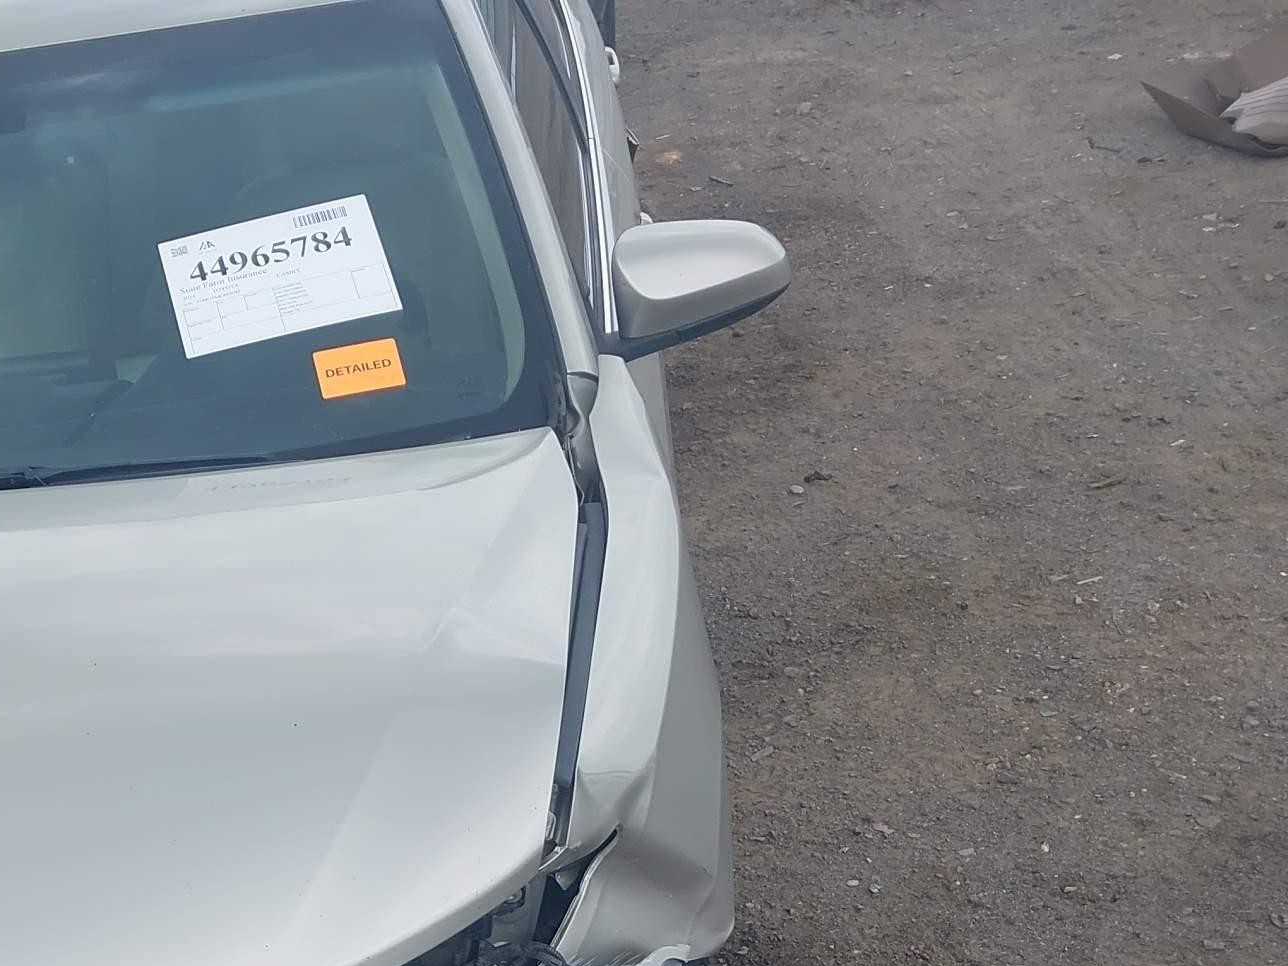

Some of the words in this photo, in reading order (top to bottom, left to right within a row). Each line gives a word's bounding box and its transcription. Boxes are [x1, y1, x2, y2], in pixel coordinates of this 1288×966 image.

[189, 226, 353, 282] 44965784
[227, 269, 267, 282] Insurance
[325, 358, 392, 379] DETAILED
